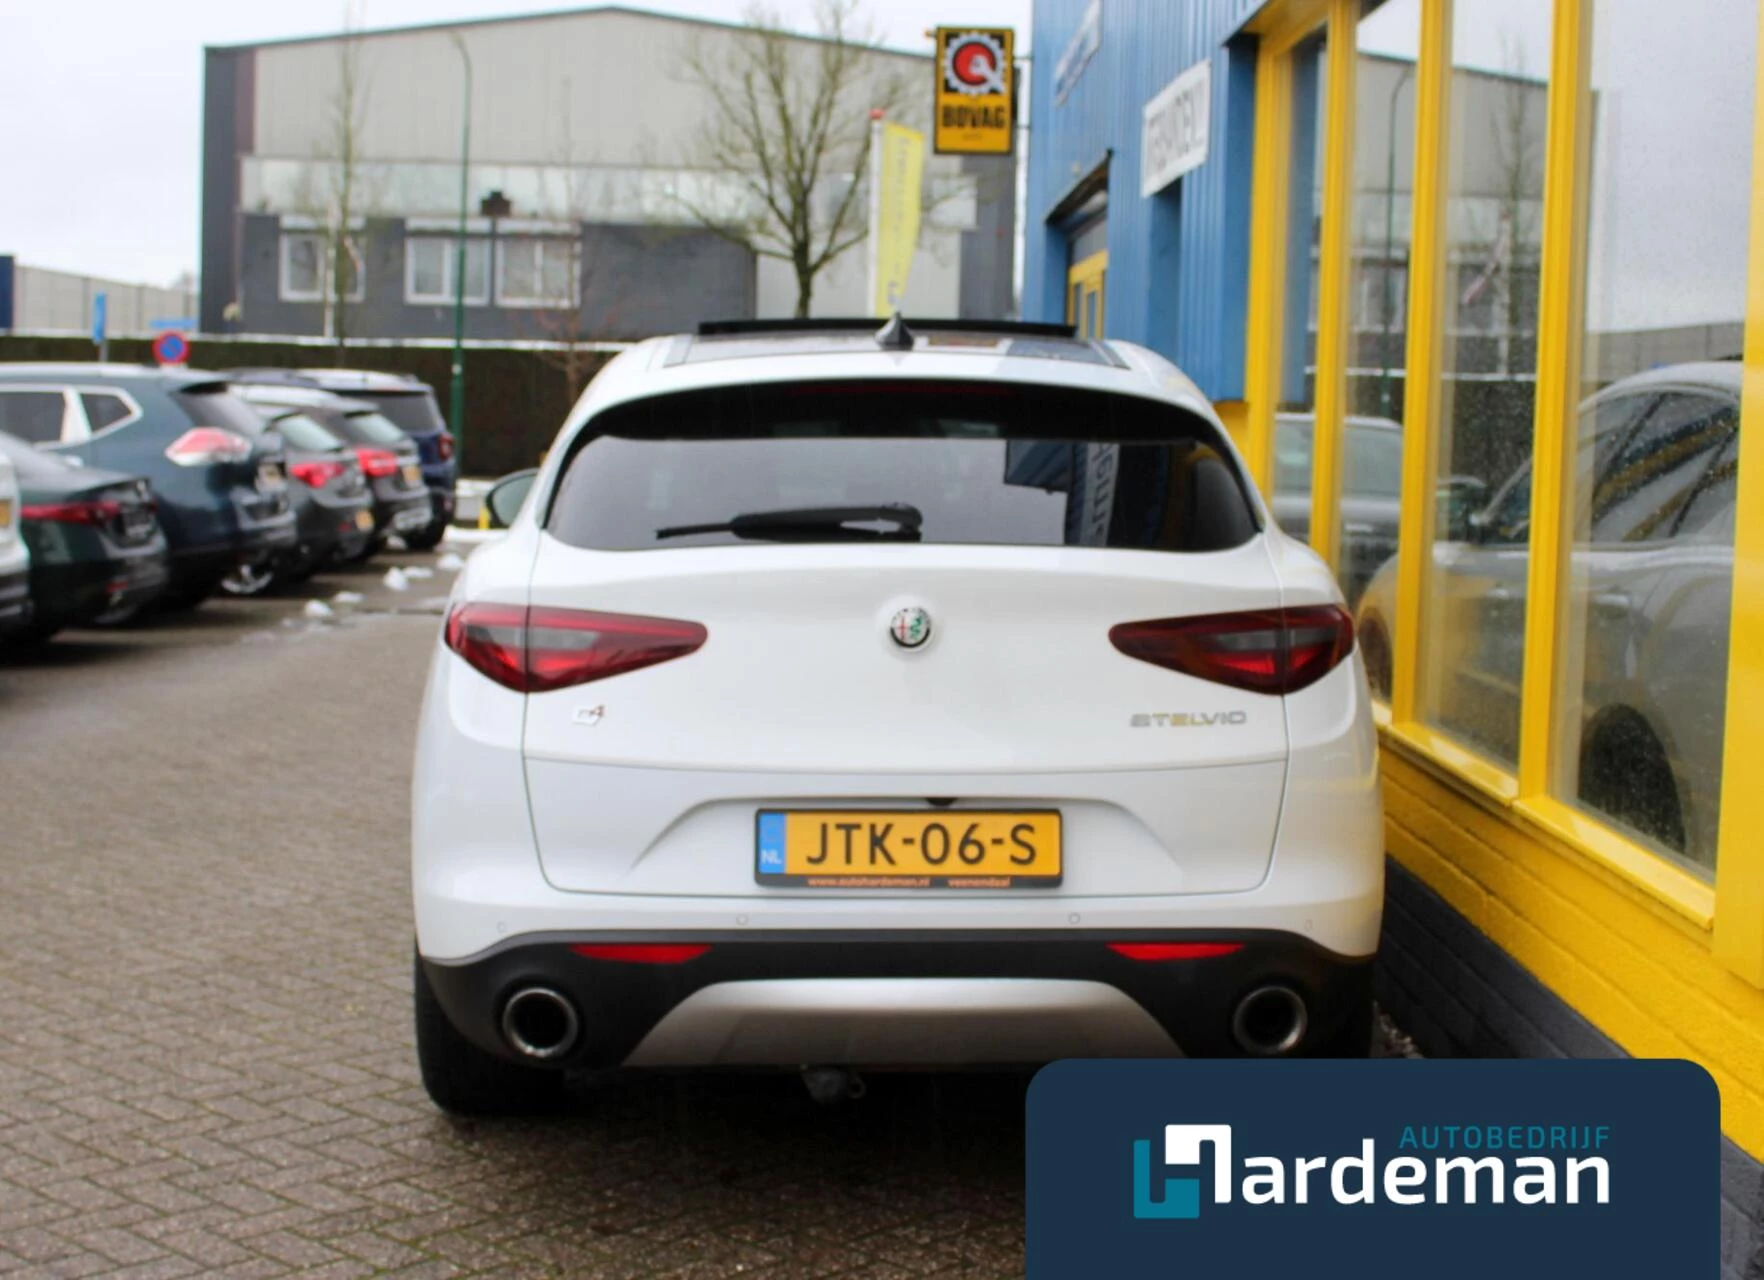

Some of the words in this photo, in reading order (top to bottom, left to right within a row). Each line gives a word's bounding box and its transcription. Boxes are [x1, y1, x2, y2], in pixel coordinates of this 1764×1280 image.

[942, 104, 1005, 128] BOVAG
[806, 821, 1037, 866] JTK-06-S
[761, 849, 782, 864] NL
